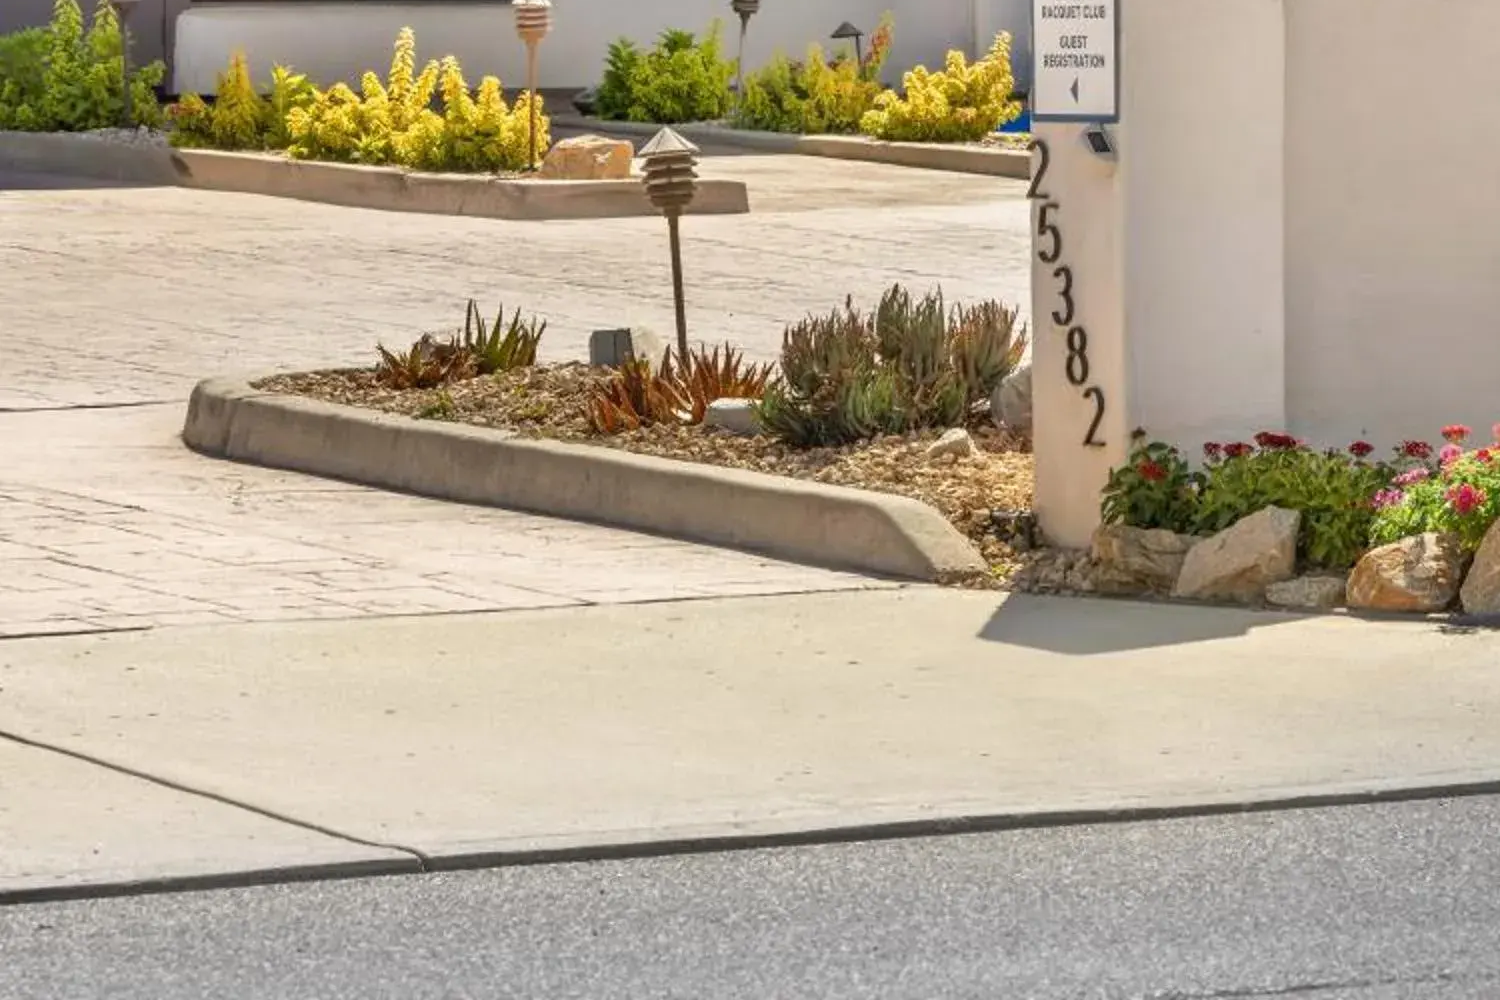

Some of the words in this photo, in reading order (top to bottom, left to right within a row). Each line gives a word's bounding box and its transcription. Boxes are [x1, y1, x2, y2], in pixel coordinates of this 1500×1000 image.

[1042, 5, 1081, 20] RACQUET
[1083, 5, 1106, 19] CLUB
[1059, 35, 1088, 49] GUEST
[1043, 54, 1105, 69] REGISTRATION
